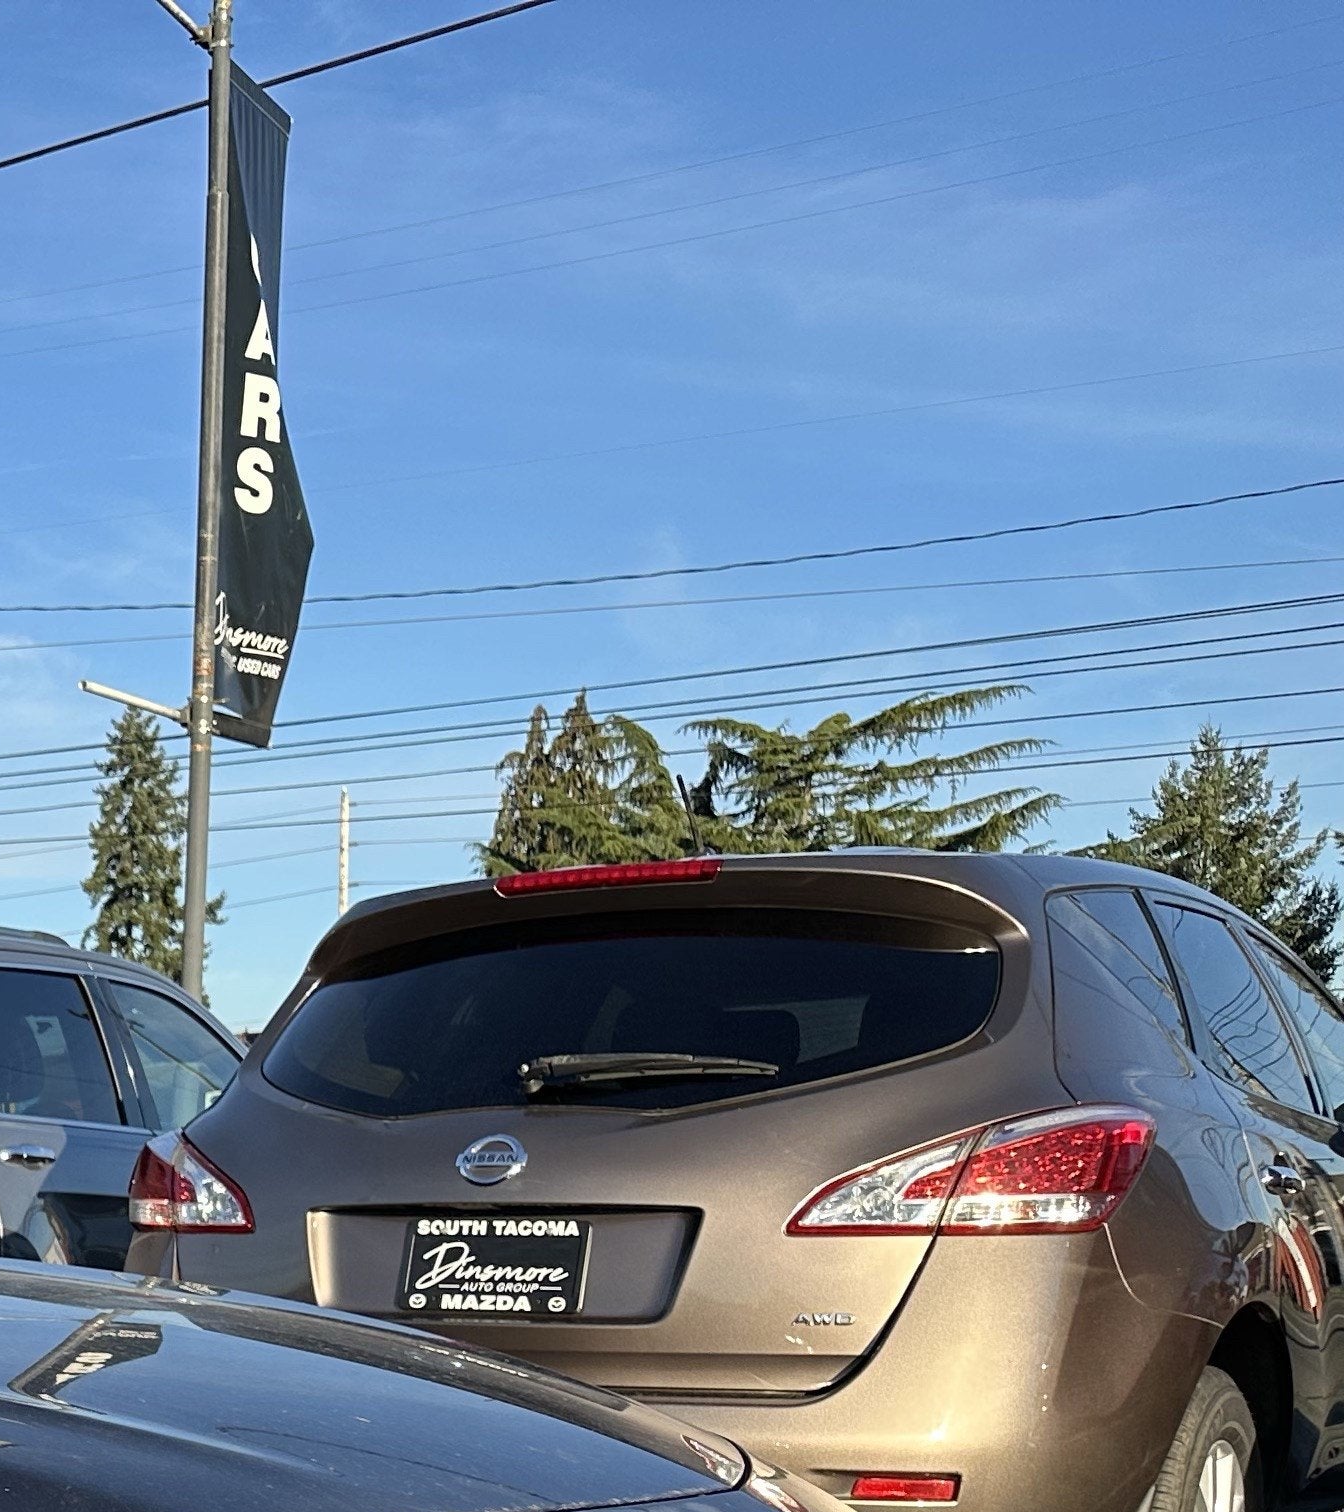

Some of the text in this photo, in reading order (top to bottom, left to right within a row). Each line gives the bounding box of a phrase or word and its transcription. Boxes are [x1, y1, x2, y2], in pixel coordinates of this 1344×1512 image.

[234, 232, 281, 515] ARS
[461, 1151, 519, 1164] NISSAN
[417, 1219, 580, 1237] SOUTH TACOMA
[415, 1241, 569, 1290] Dinsmore
[460, 1281, 541, 1294] AUTO GROUP
[440, 1293, 532, 1312] MAZDA
[791, 1312, 856, 1326] AWD
